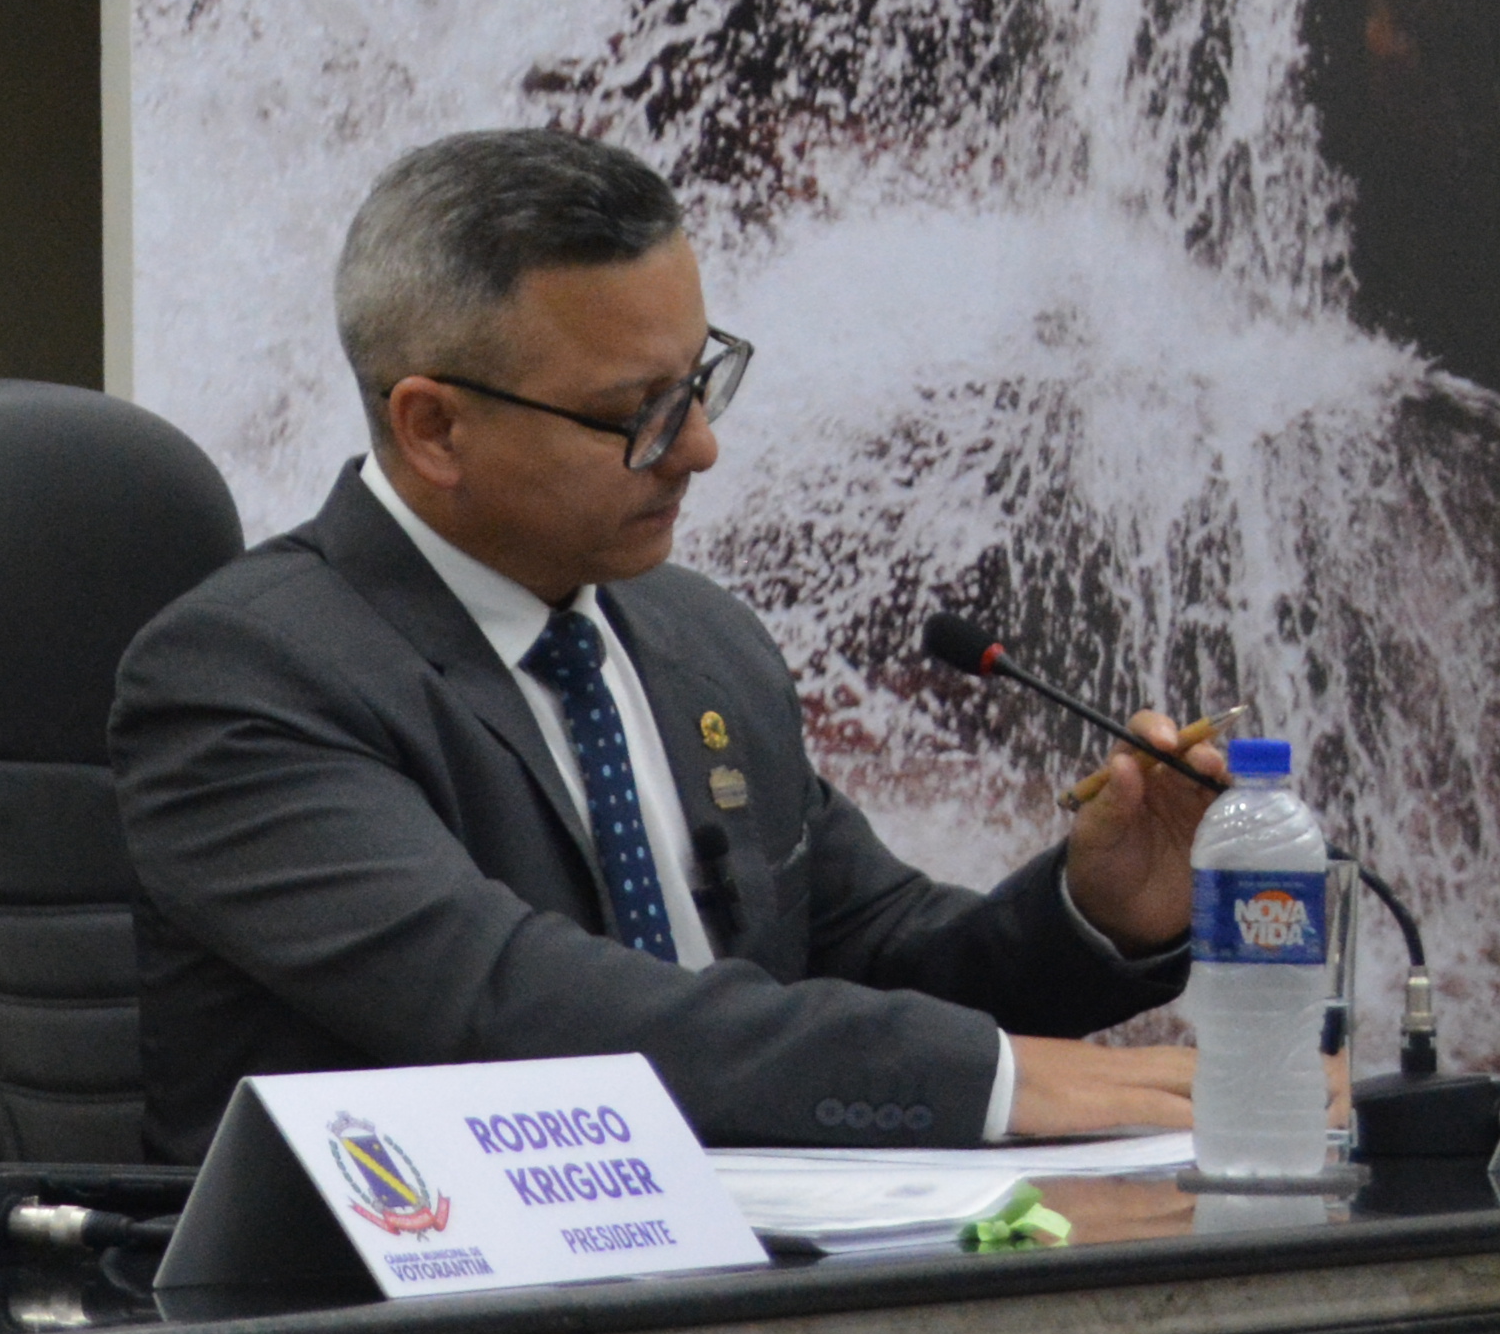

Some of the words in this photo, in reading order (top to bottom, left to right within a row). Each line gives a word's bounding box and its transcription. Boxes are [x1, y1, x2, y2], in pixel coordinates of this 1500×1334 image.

[1234, 898, 1310, 924] NOVA
[1238, 921, 1305, 945] VIDA
[464, 1105, 631, 1154] RODRIGO
[504, 1157, 664, 1206] KRIGUER
[560, 1219, 677, 1254] PRESIDENTE
[390, 1258, 494, 1282] VOTORANTIM
